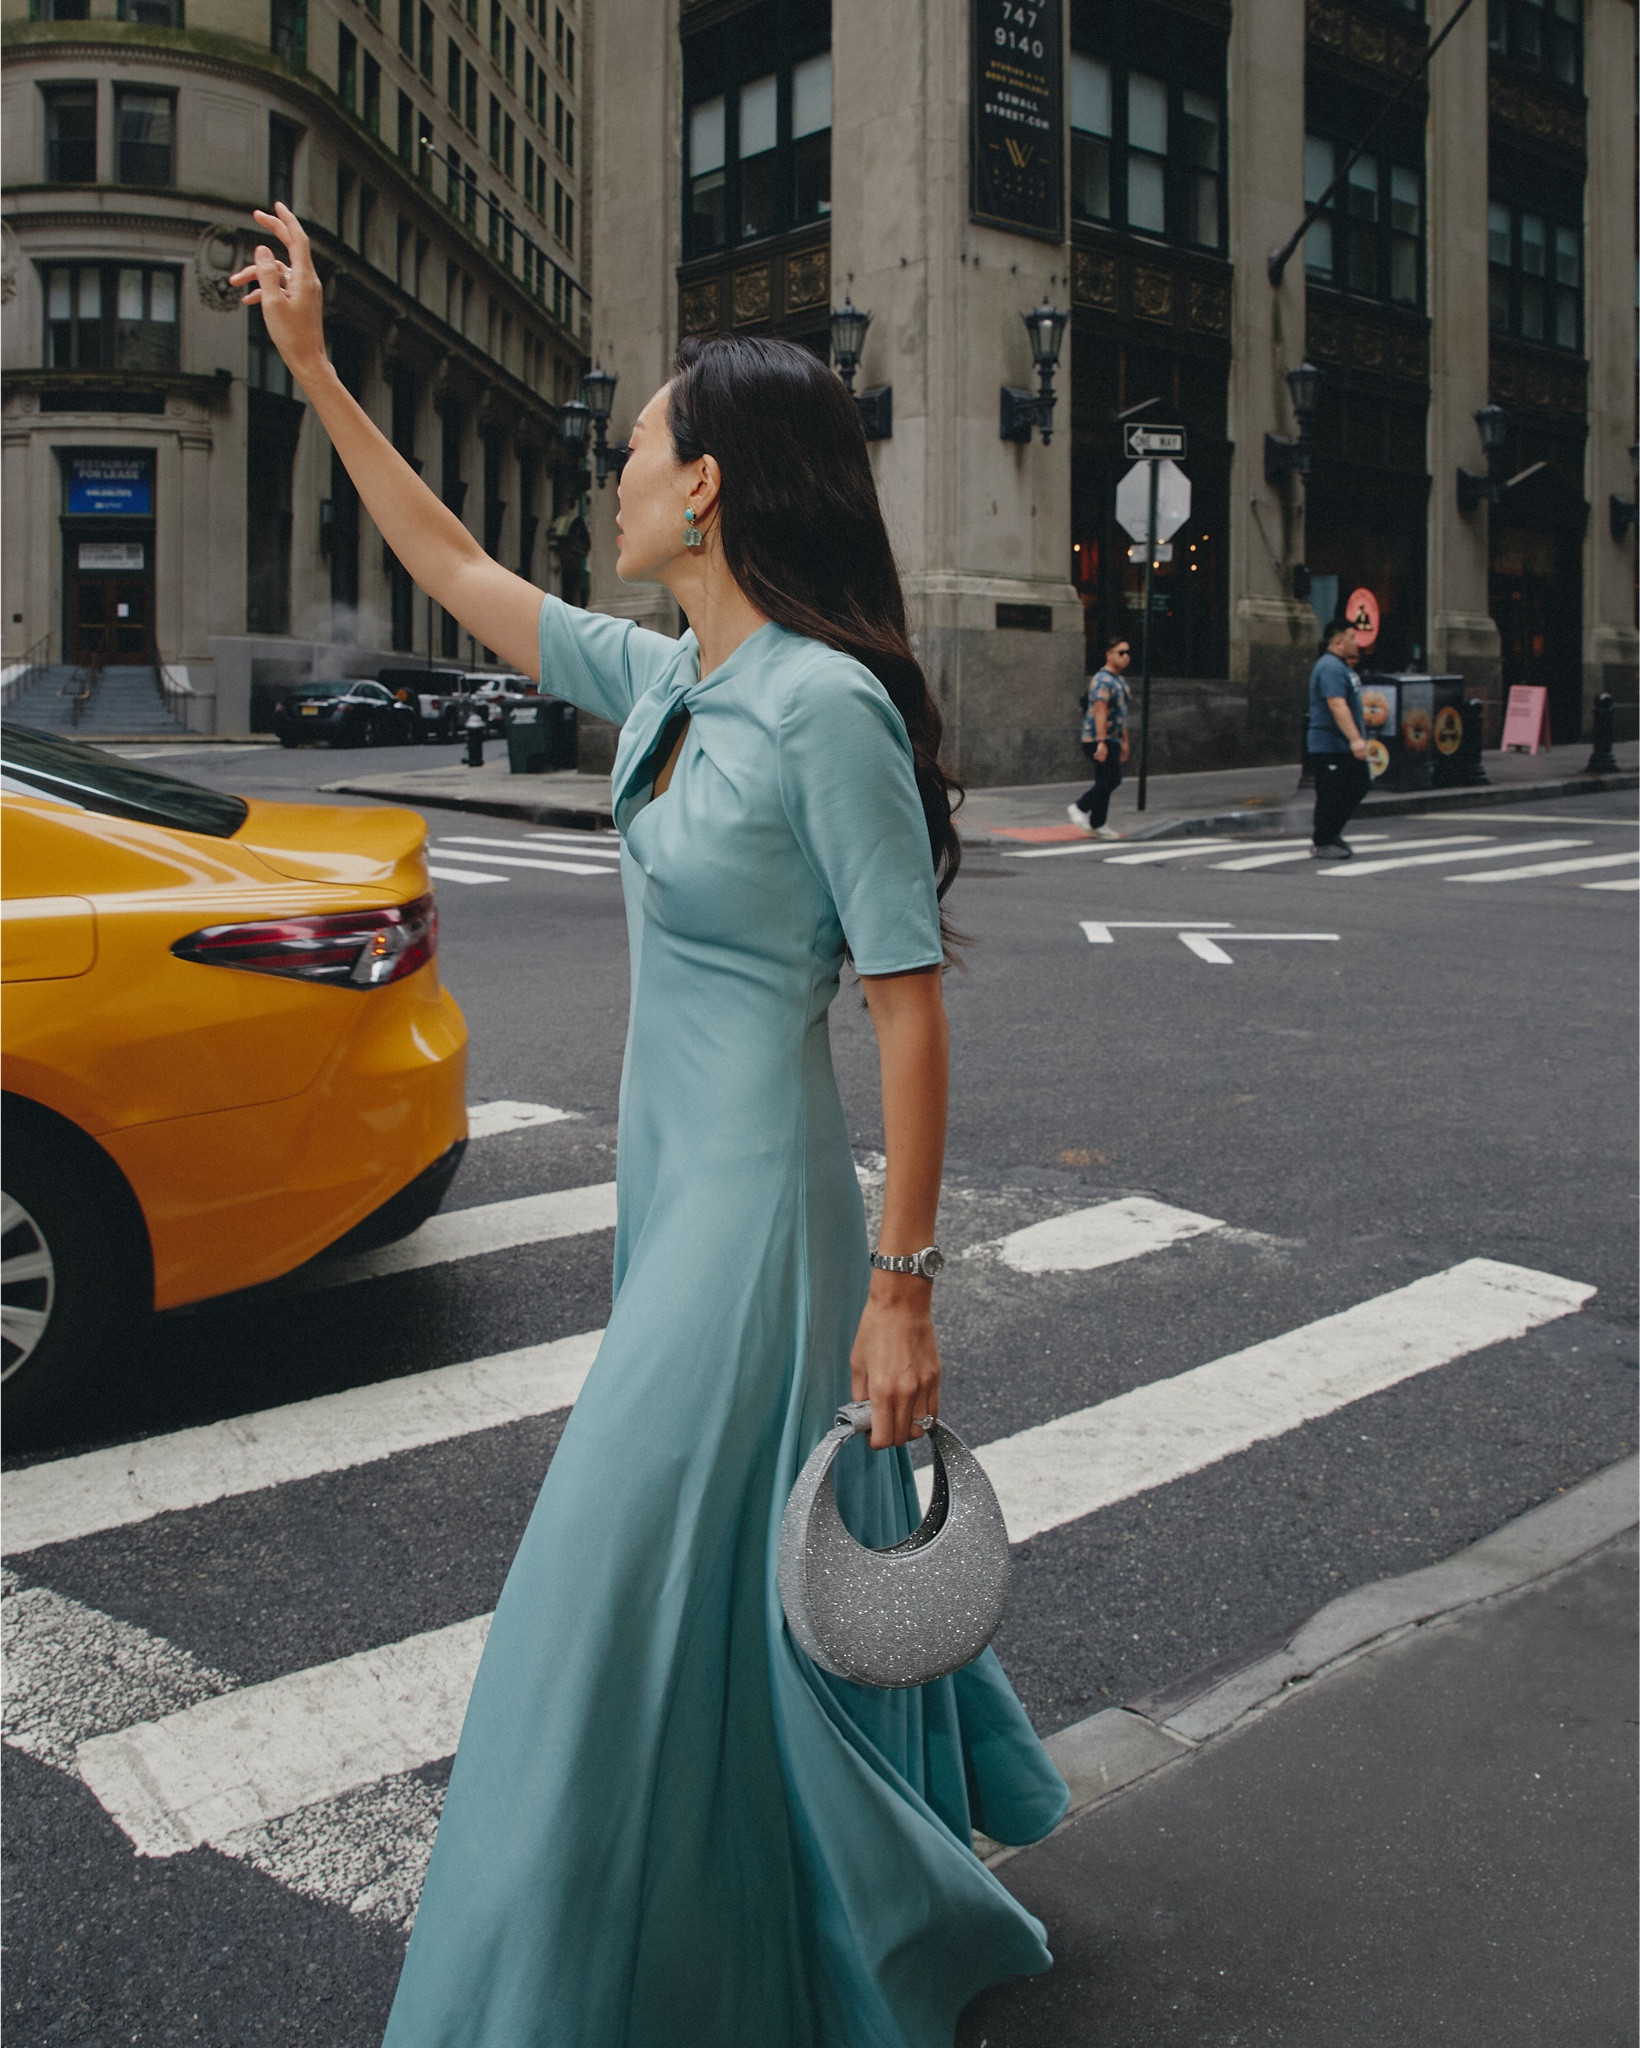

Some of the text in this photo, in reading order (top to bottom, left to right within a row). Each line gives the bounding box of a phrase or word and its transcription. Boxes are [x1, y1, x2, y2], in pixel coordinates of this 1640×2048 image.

[1001, 1, 1038, 28] 747
[994, 26, 1044, 59] 9140
[985, 103, 1050, 130] STREET.COM
[1135, 434, 1178, 449] ONE WAY
[79, 470, 139, 480] FOR LEASE
